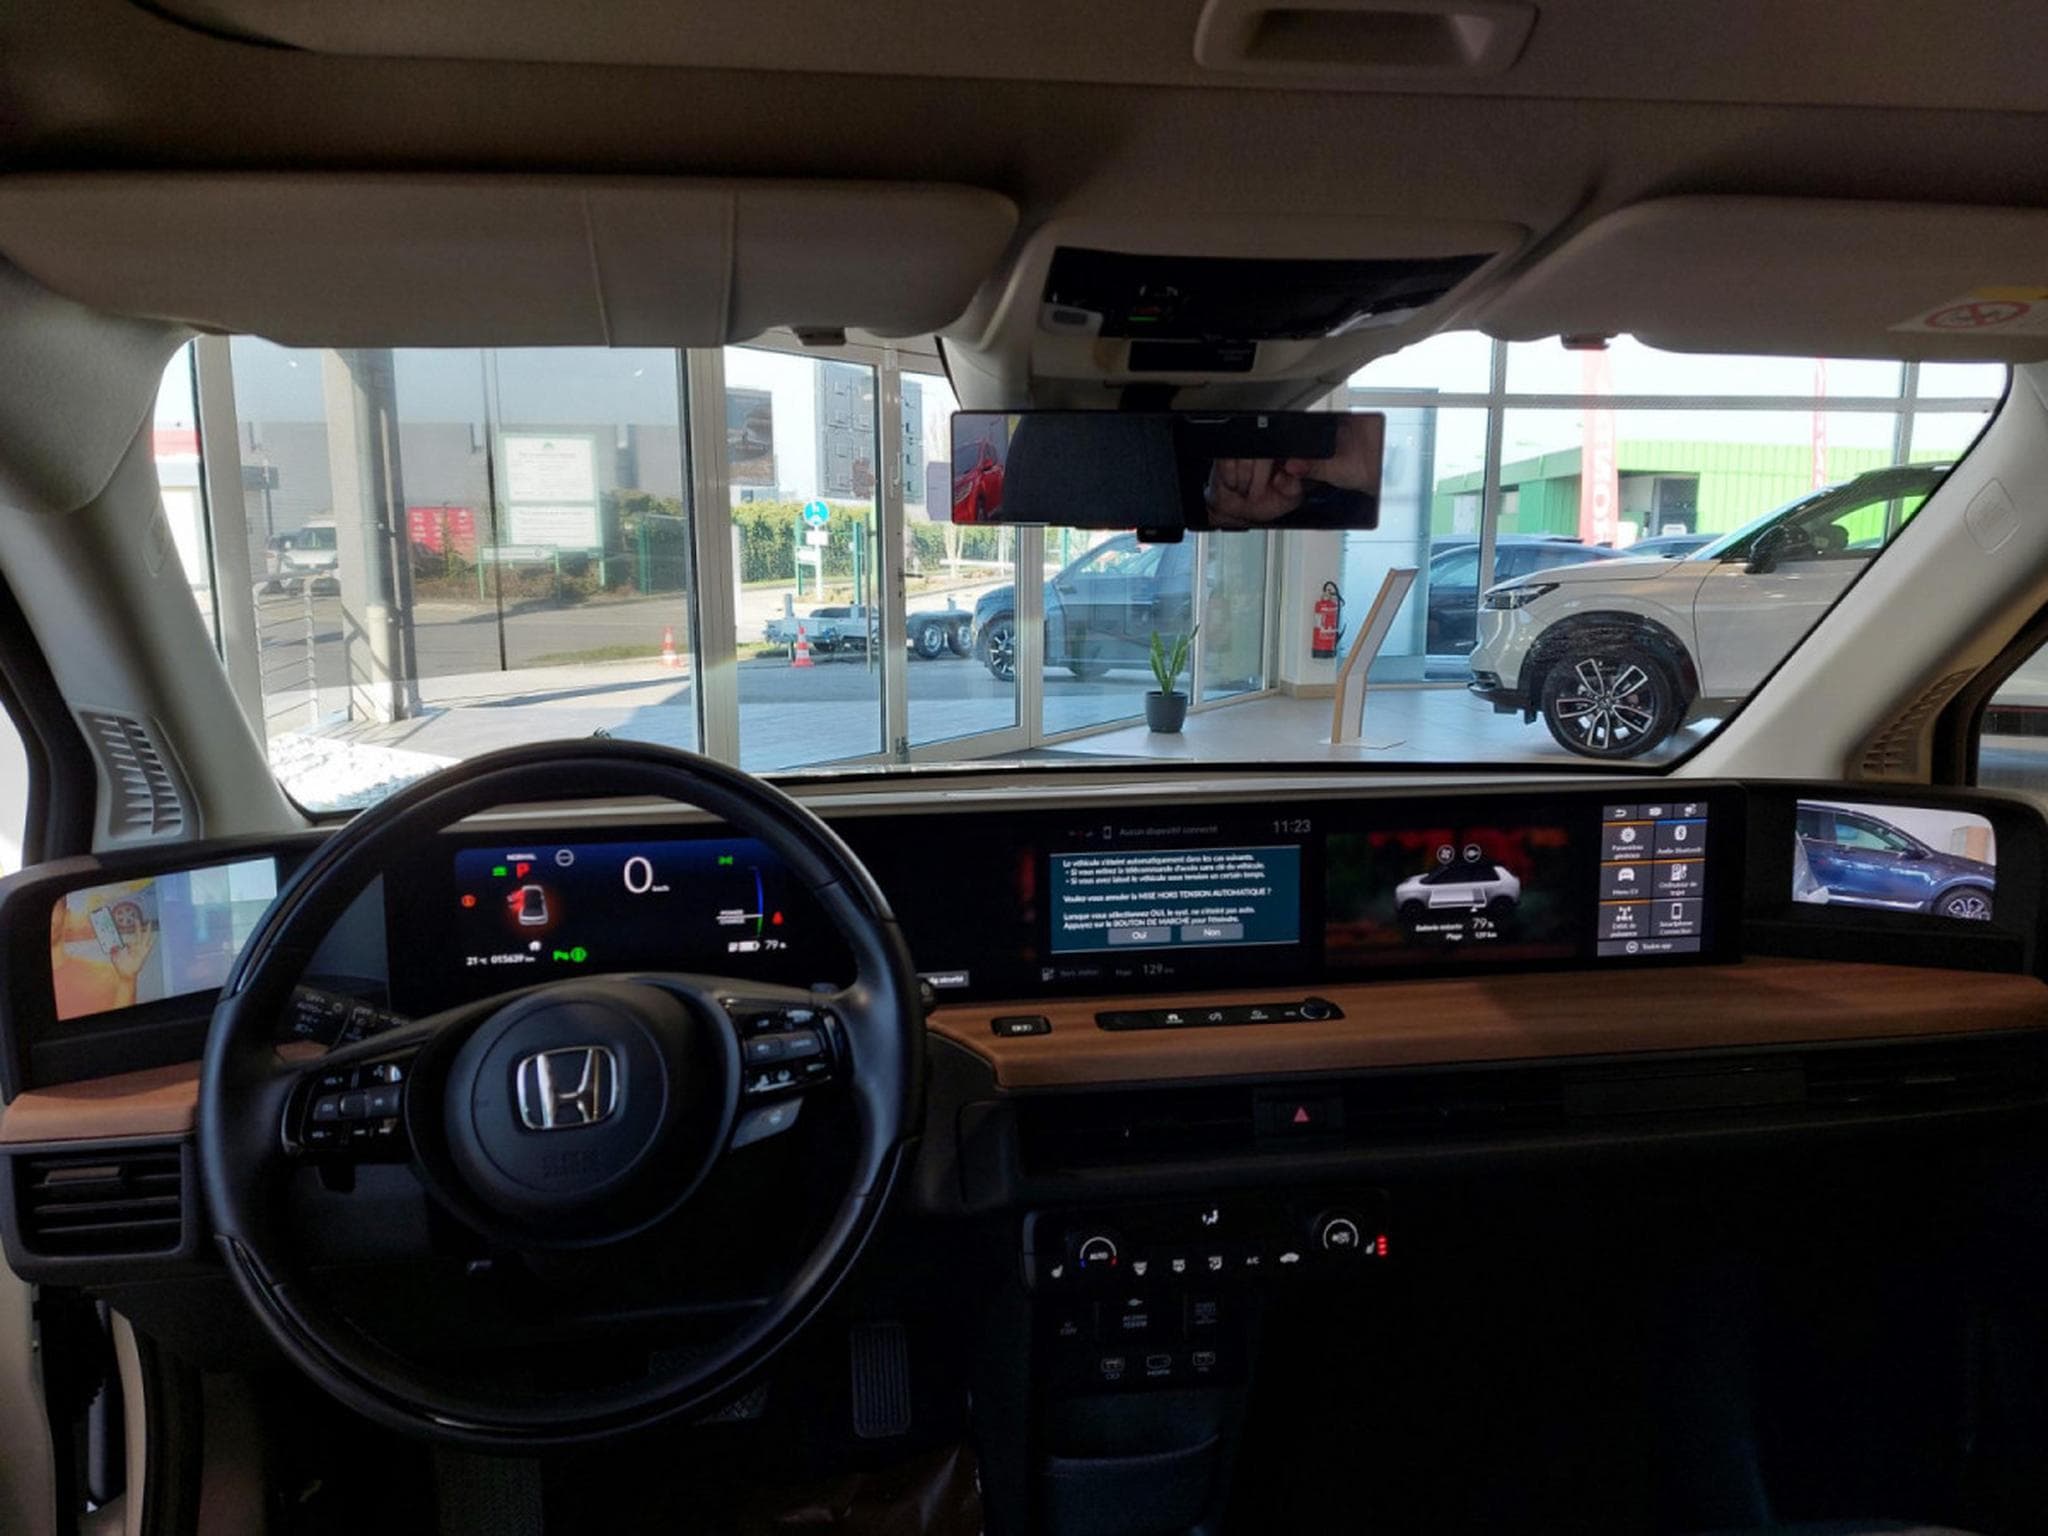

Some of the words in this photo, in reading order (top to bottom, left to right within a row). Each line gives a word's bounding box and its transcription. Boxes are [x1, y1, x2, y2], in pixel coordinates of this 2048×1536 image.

[1273, 819, 1312, 834] 11:23
[517, 862, 530, 879] P
[624, 856, 653, 894] 0
[1472, 917, 1487, 929] 79
[1132, 929, 1148, 939] Oui
[1203, 927, 1222, 937] Non
[765, 940, 779, 951] 79
